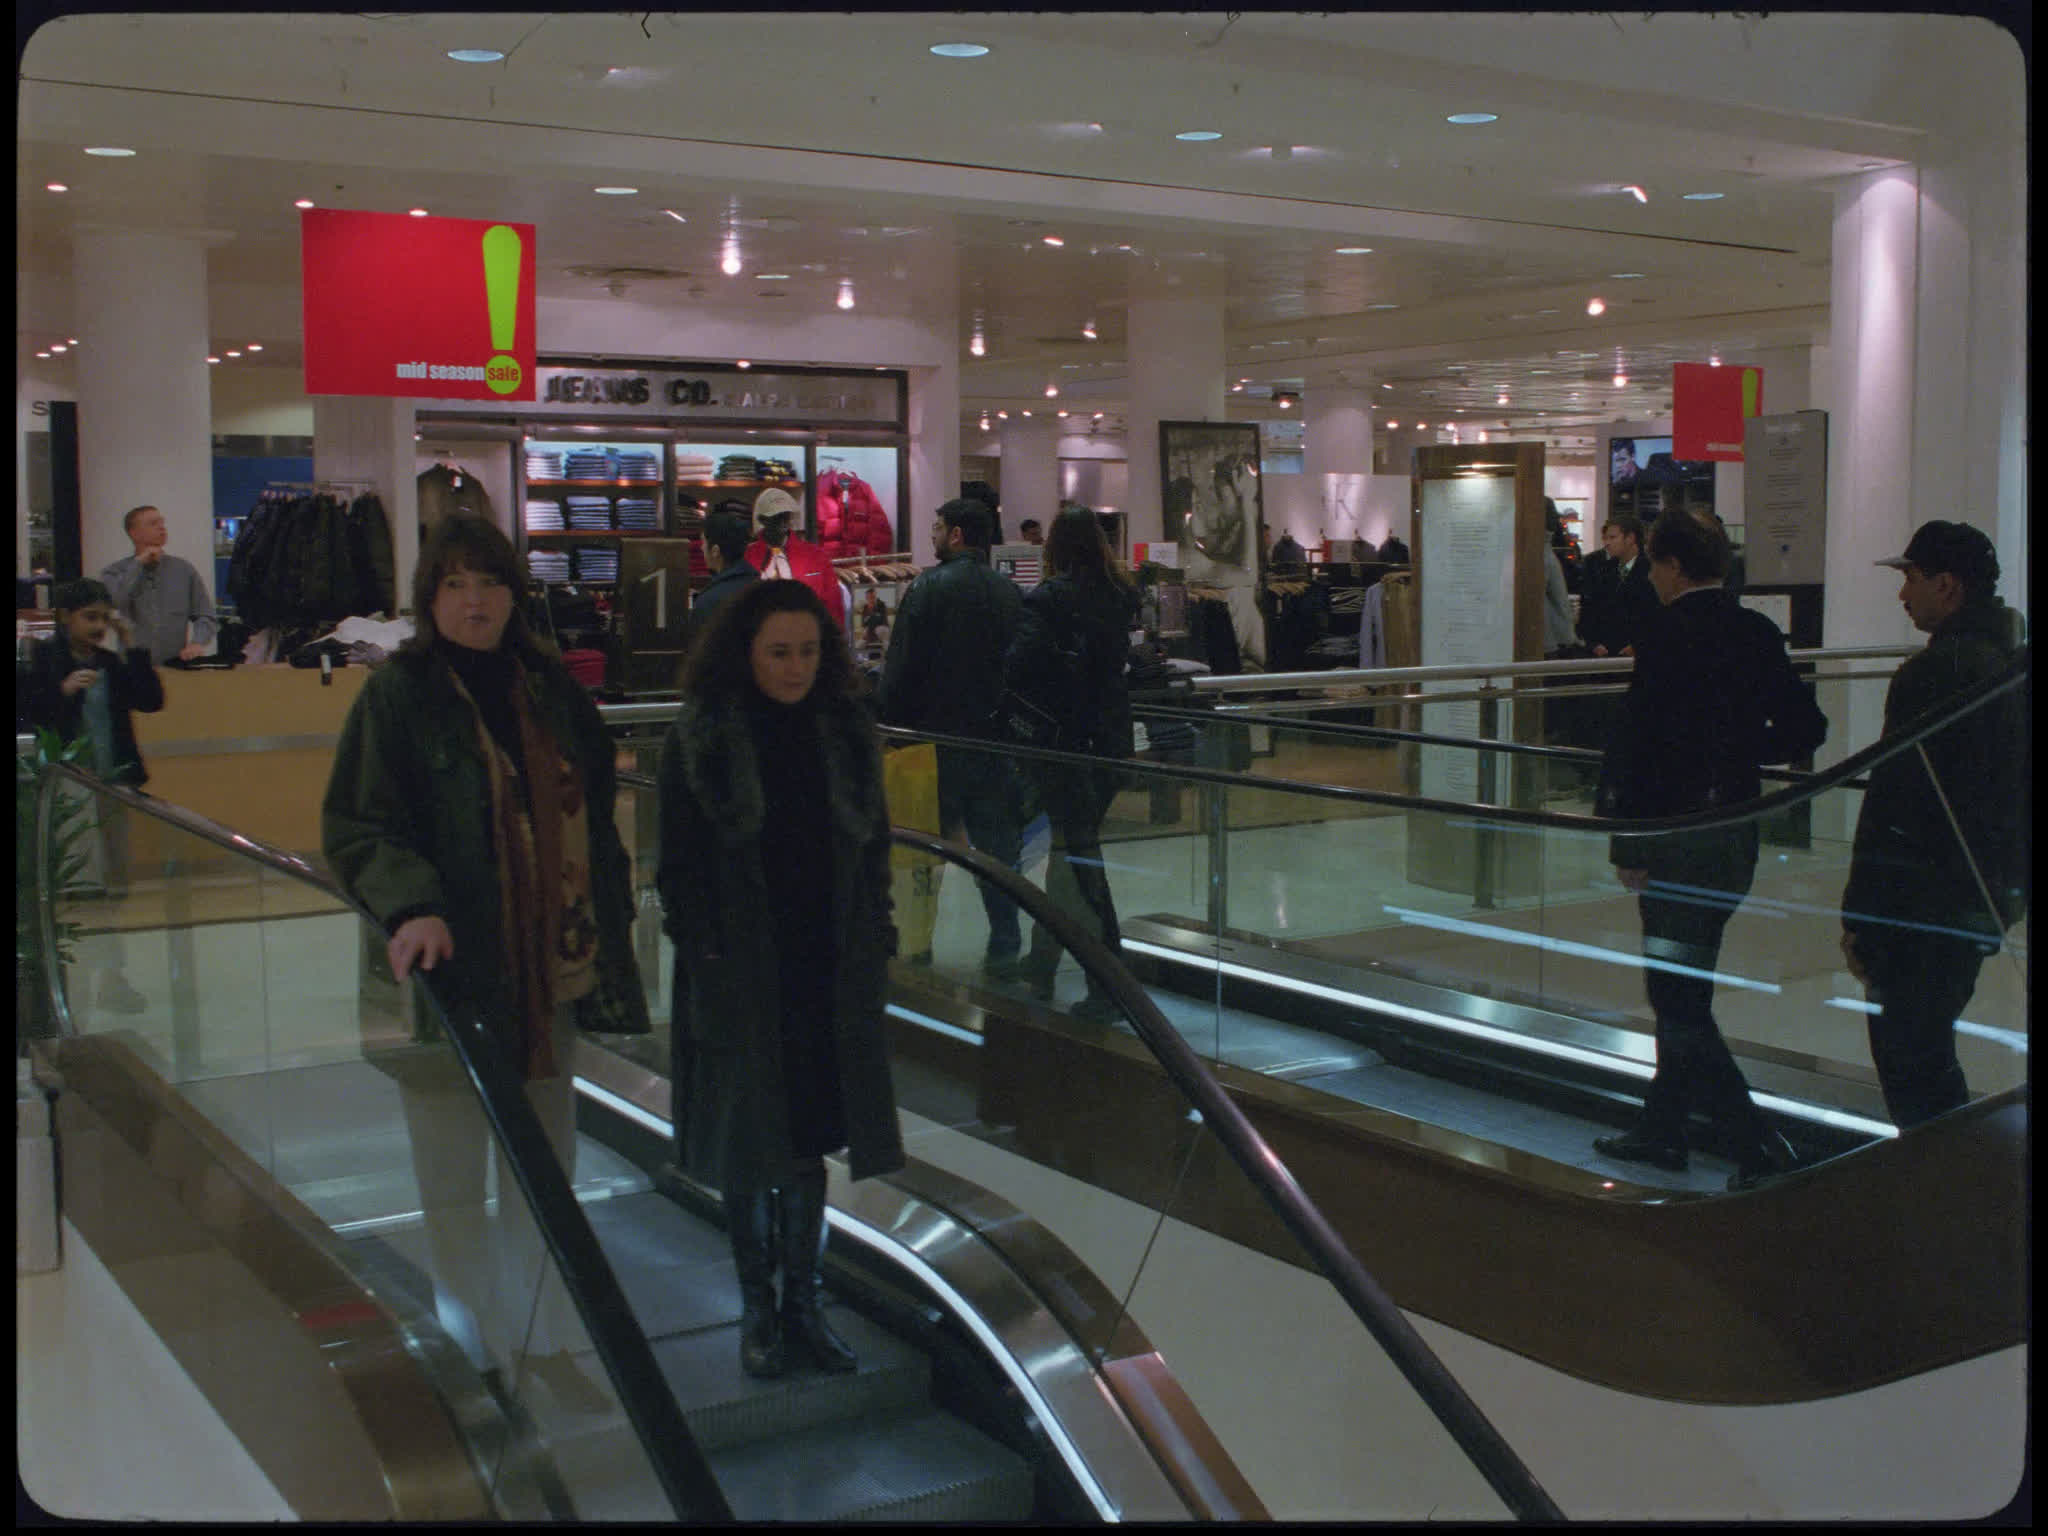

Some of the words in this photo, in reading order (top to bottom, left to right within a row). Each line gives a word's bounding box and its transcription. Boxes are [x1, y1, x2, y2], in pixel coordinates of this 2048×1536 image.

[395, 361, 427, 379] mid
[429, 364, 486, 382] season
[487, 365, 519, 382] sale
[544, 375, 649, 405] JEANS
[665, 379, 717, 405] CO.
[639, 567, 667, 629] 1
